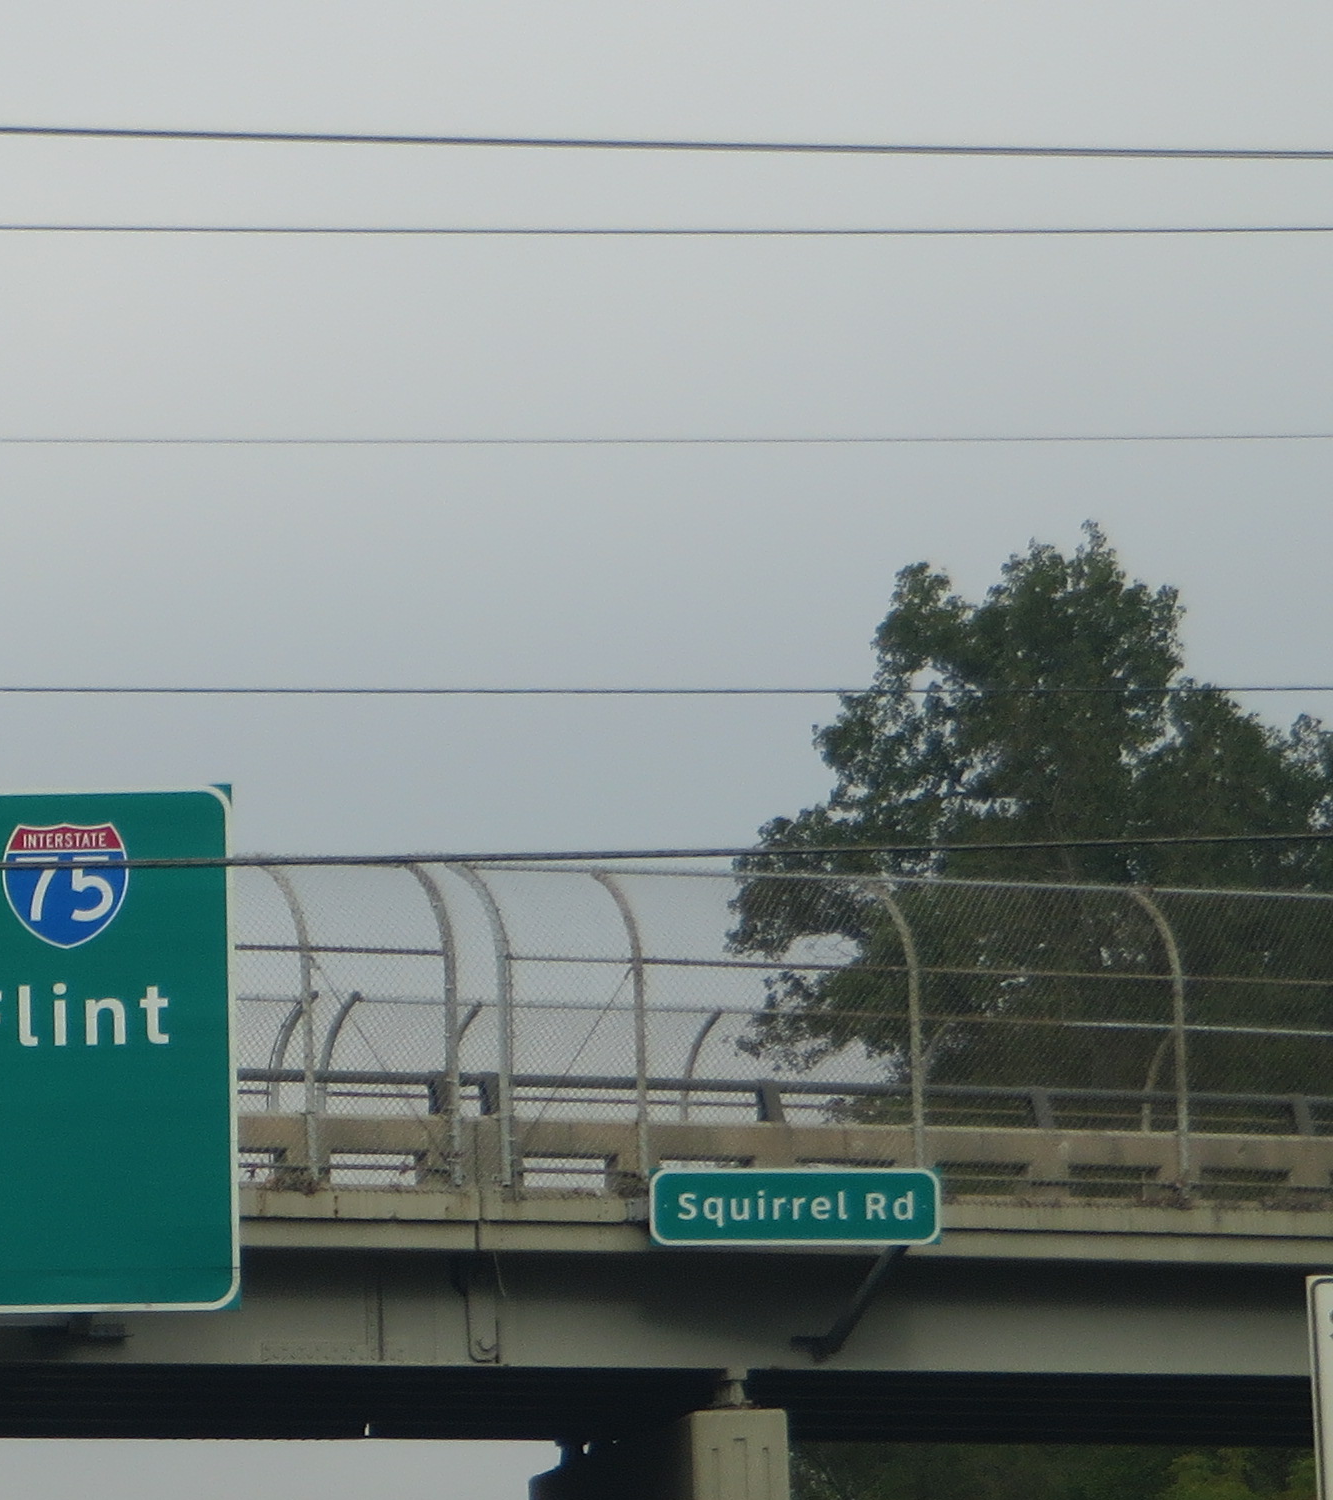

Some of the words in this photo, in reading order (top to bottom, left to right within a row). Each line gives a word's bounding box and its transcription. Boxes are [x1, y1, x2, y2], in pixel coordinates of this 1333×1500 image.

[23, 832, 107, 848] INTERSTATE
[15, 855, 114, 921] 75
[677, 1190, 848, 1228] Squirrel
[865, 1190, 914, 1221] Rd
